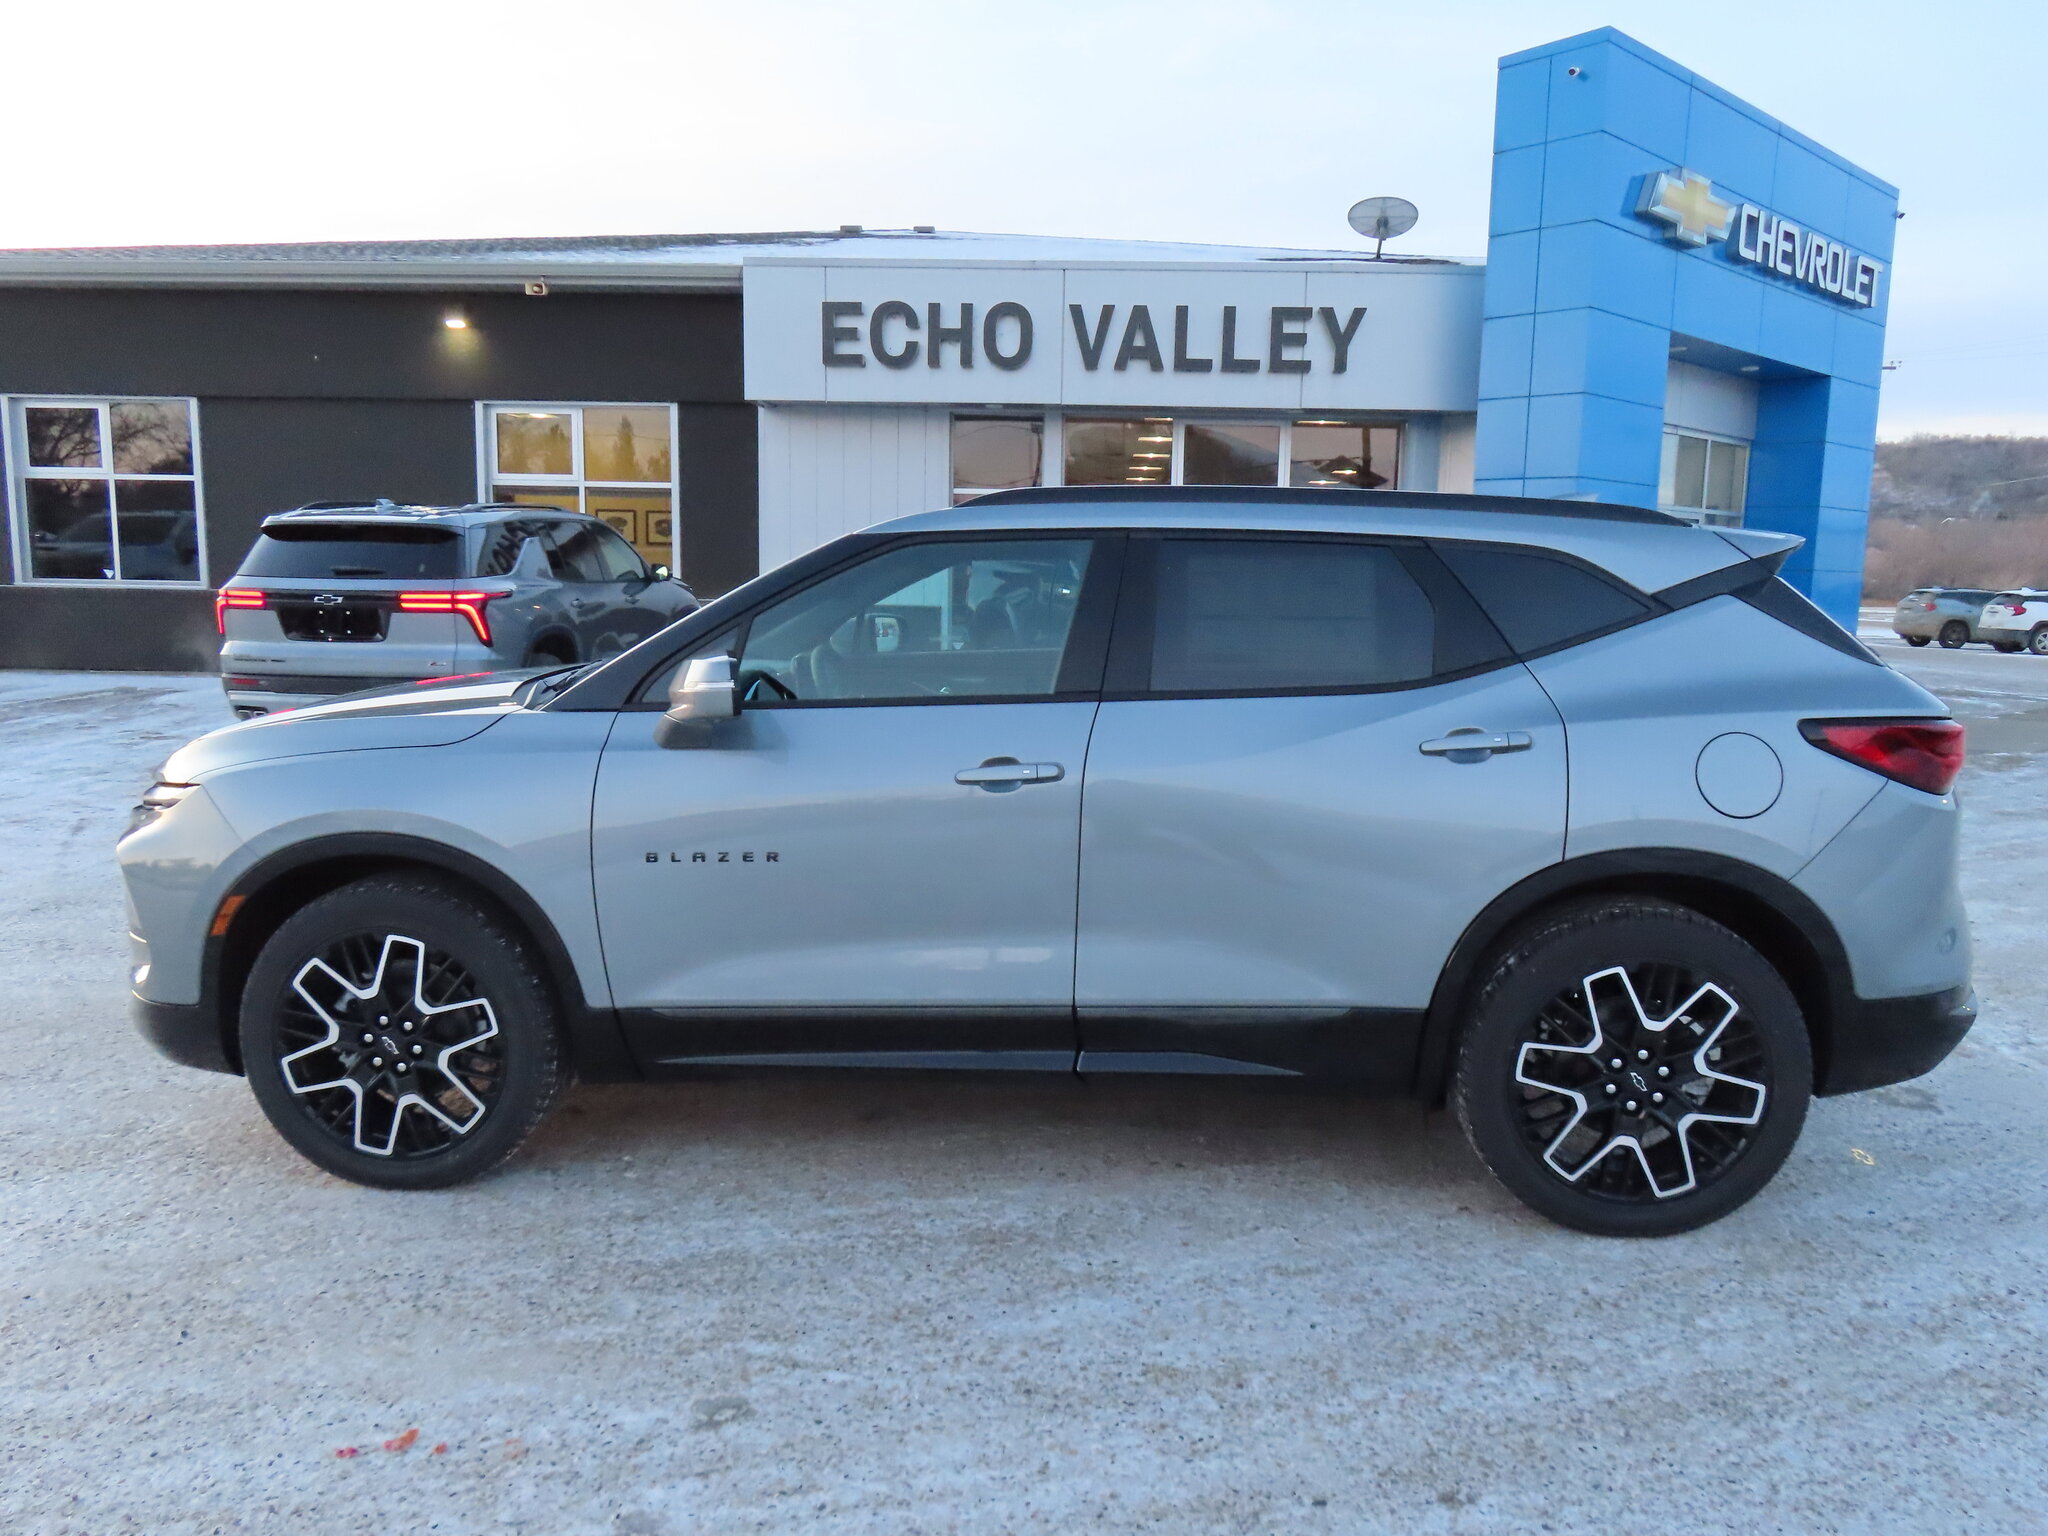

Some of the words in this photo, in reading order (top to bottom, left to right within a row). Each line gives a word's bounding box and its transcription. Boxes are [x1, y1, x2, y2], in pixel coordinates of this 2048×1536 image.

[1738, 203, 1883, 307] CHEVROLET
[822, 301, 1034, 370] ECHO
[1068, 304, 1368, 375] VALLEY
[645, 851, 779, 863] BLAZER
